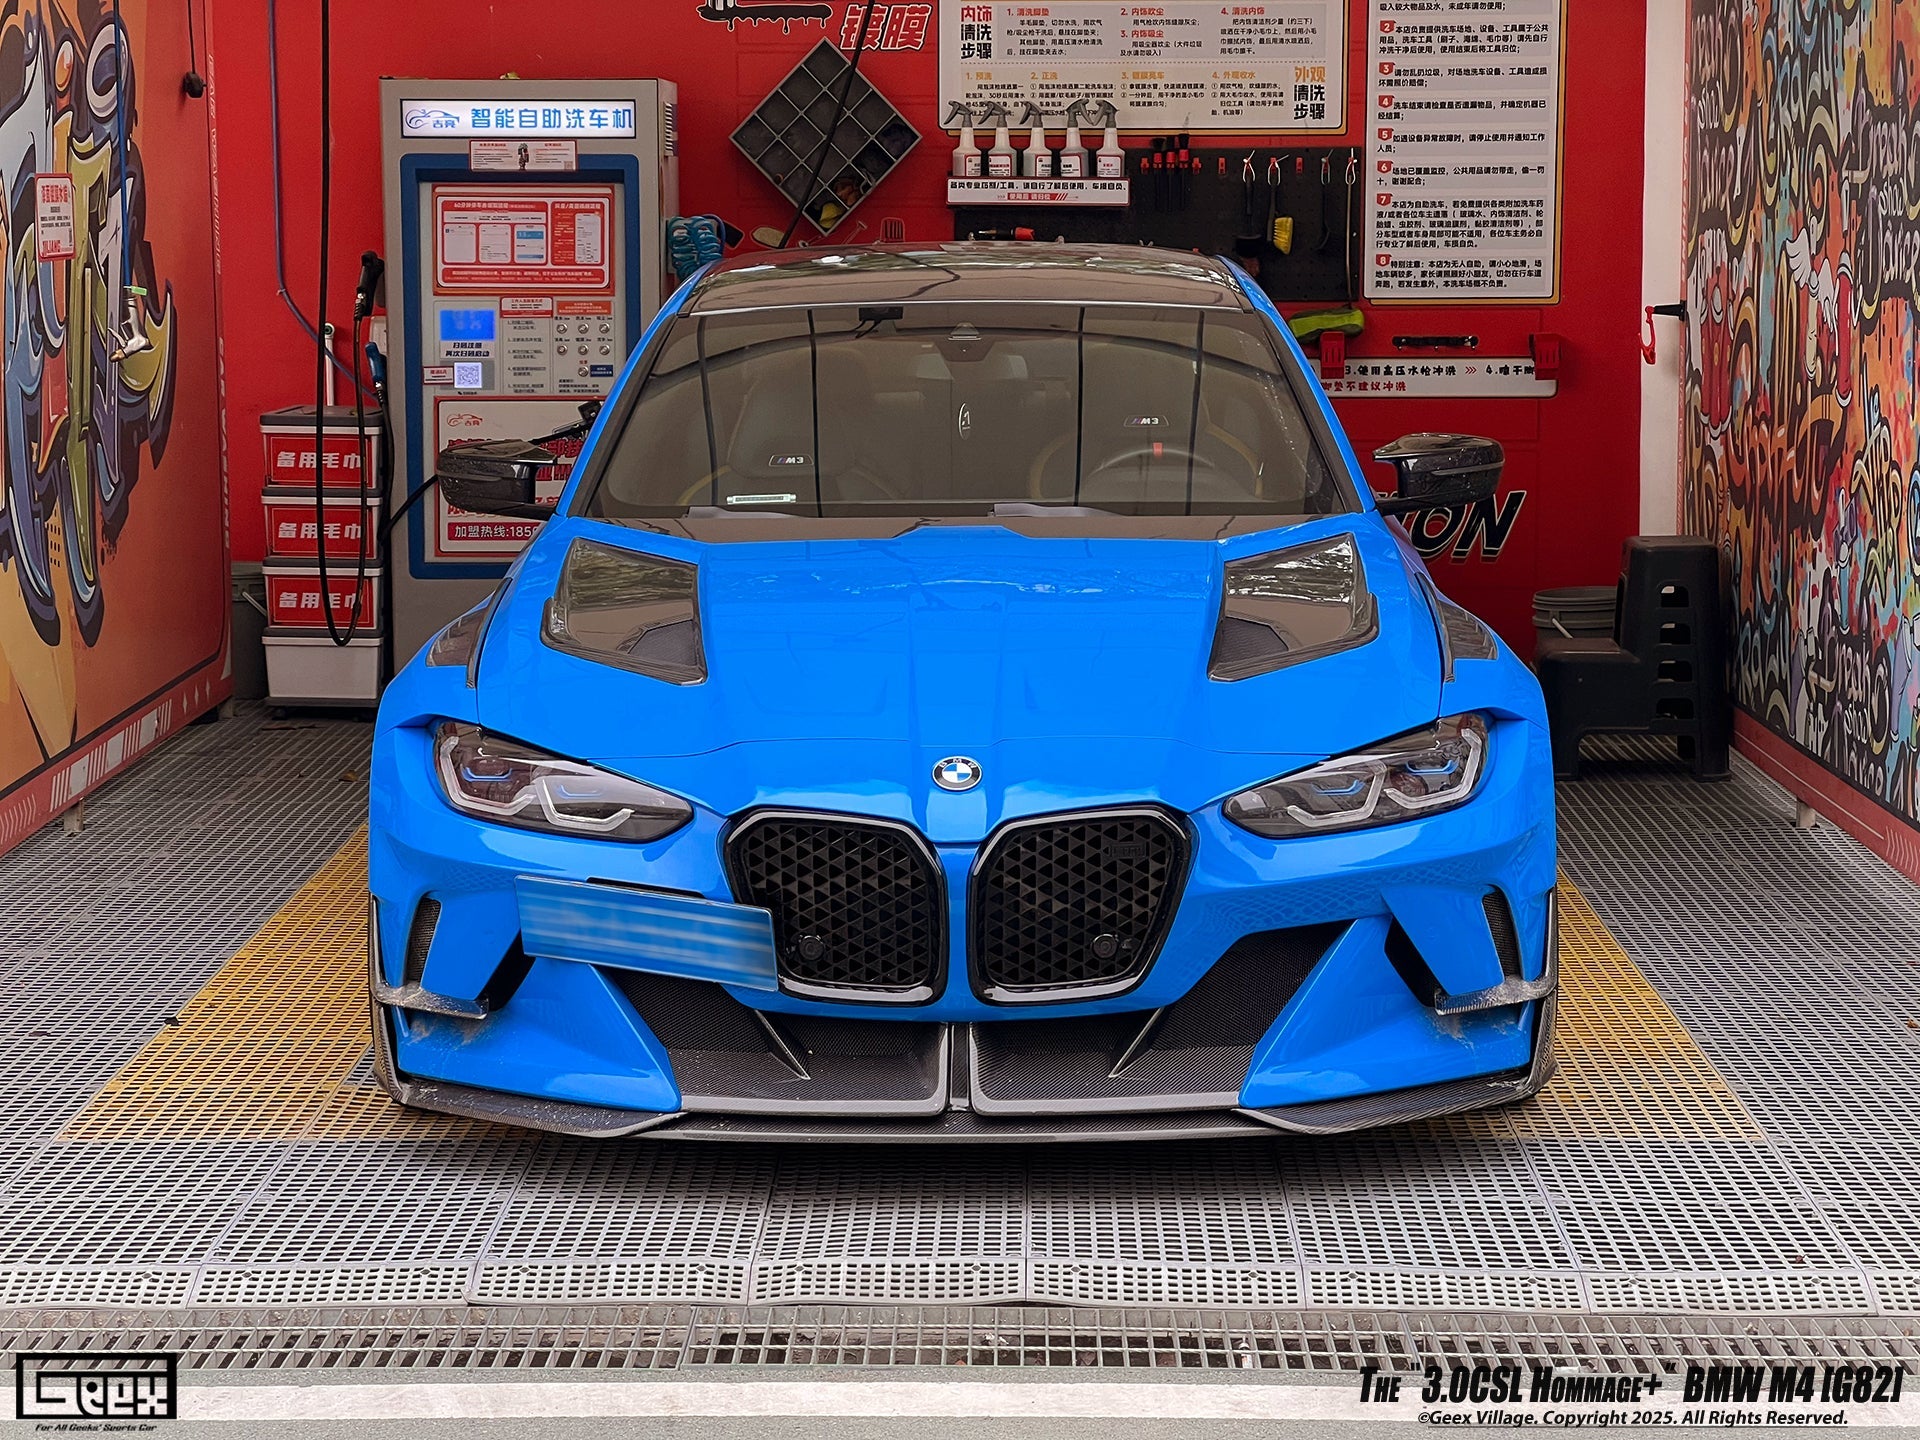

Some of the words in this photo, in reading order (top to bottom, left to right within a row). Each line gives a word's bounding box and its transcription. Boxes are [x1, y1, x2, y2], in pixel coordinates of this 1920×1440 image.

[961, 5, 992, 22] 内饰
[840, 4, 932, 50] 镀膜
[961, 24, 992, 41] 清洗
[1384, 23, 1391, 32] 2
[961, 42, 992, 59] 步骤
[1294, 66, 1326, 83] 外观
[1383, 65, 1390, 73] 3
[1293, 84, 1325, 101] 清洗
[1382, 98, 1389, 106] 4
[471, 108, 633, 129] 智能自助洗车机
[1293, 103, 1325, 120] 步骤
[1382, 130, 1388, 139] 5
[1381, 163, 1387, 171] 6
[1380, 196, 1387, 204] 7
[1380, 257, 1386, 265] 8
[1140, 417, 1159, 425] M3
[276, 451, 361, 469] 备用毛巾
[784, 456, 804, 464] M3
[278, 522, 362, 540] 备用毛巾
